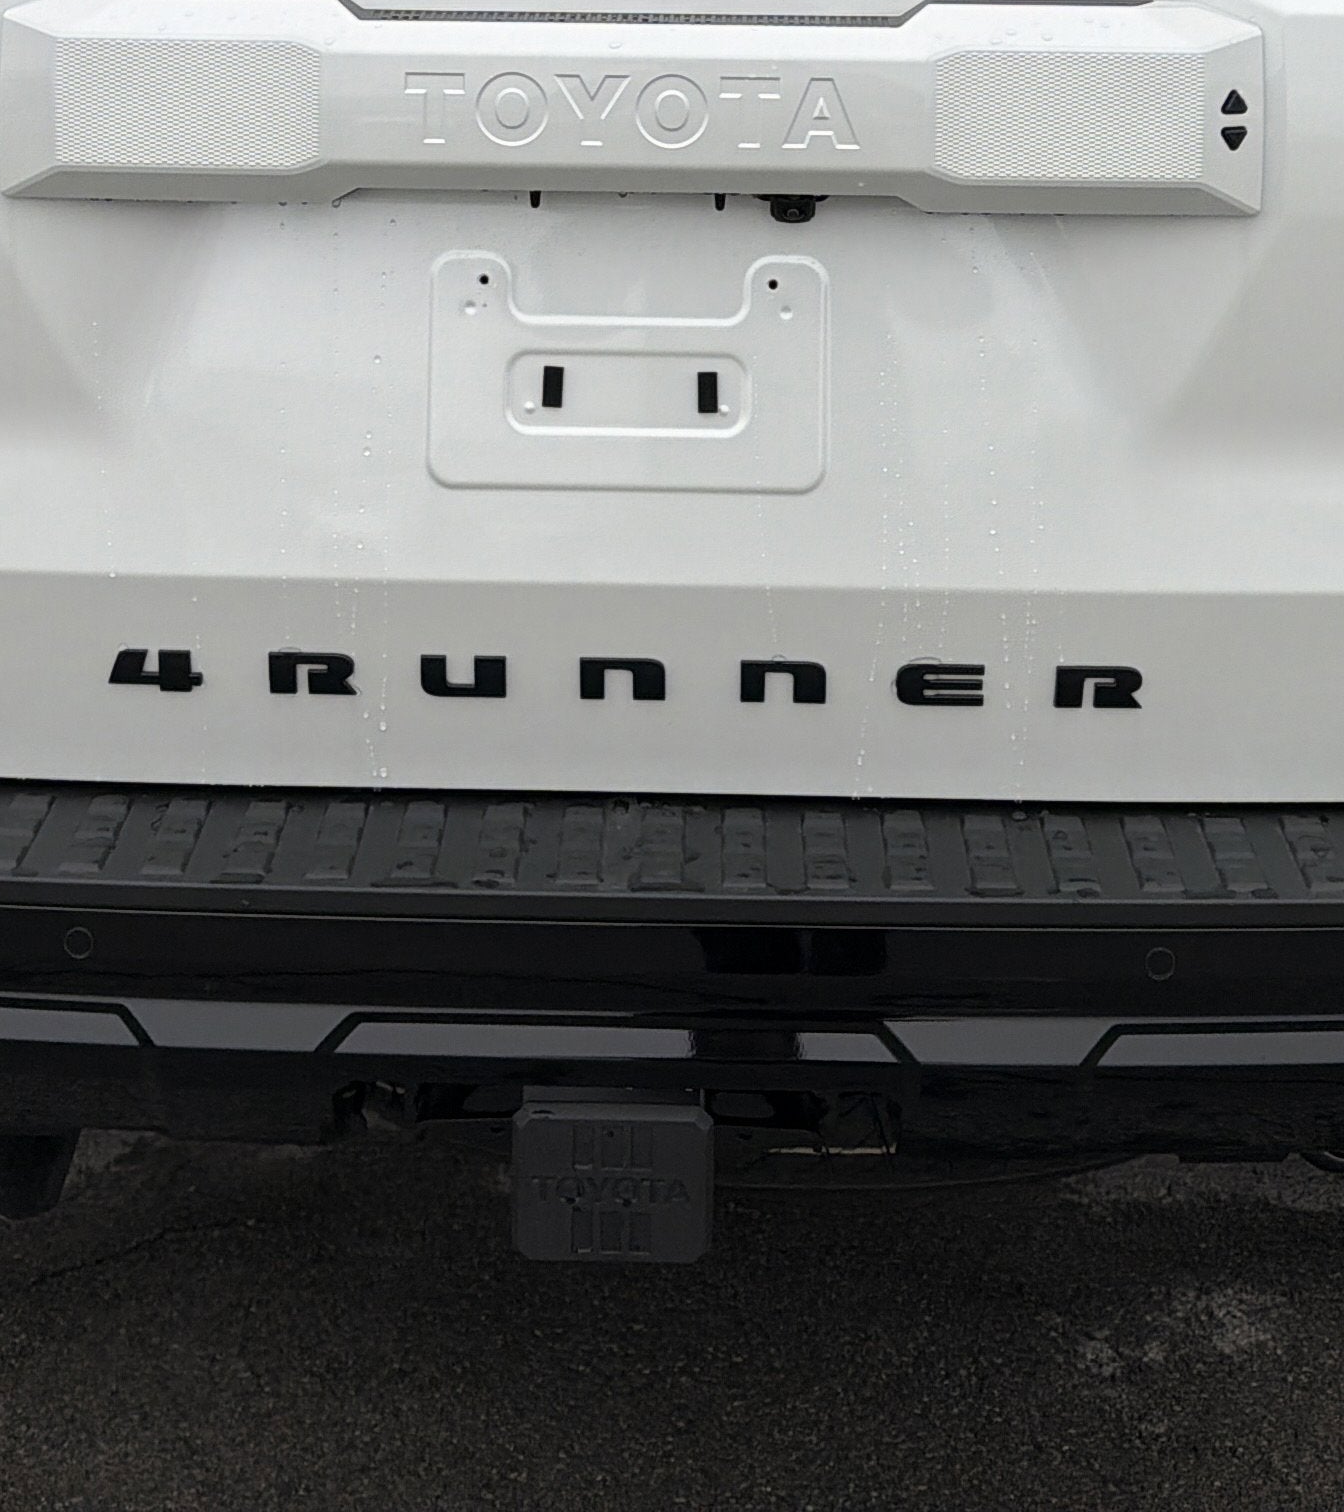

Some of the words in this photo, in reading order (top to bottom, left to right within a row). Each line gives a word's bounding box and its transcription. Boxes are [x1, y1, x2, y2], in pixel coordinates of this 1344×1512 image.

[404, 71, 862, 150] TOYOTA
[107, 647, 1144, 710] 4RUNNER
[530, 1175, 692, 1206] TOYOTA
